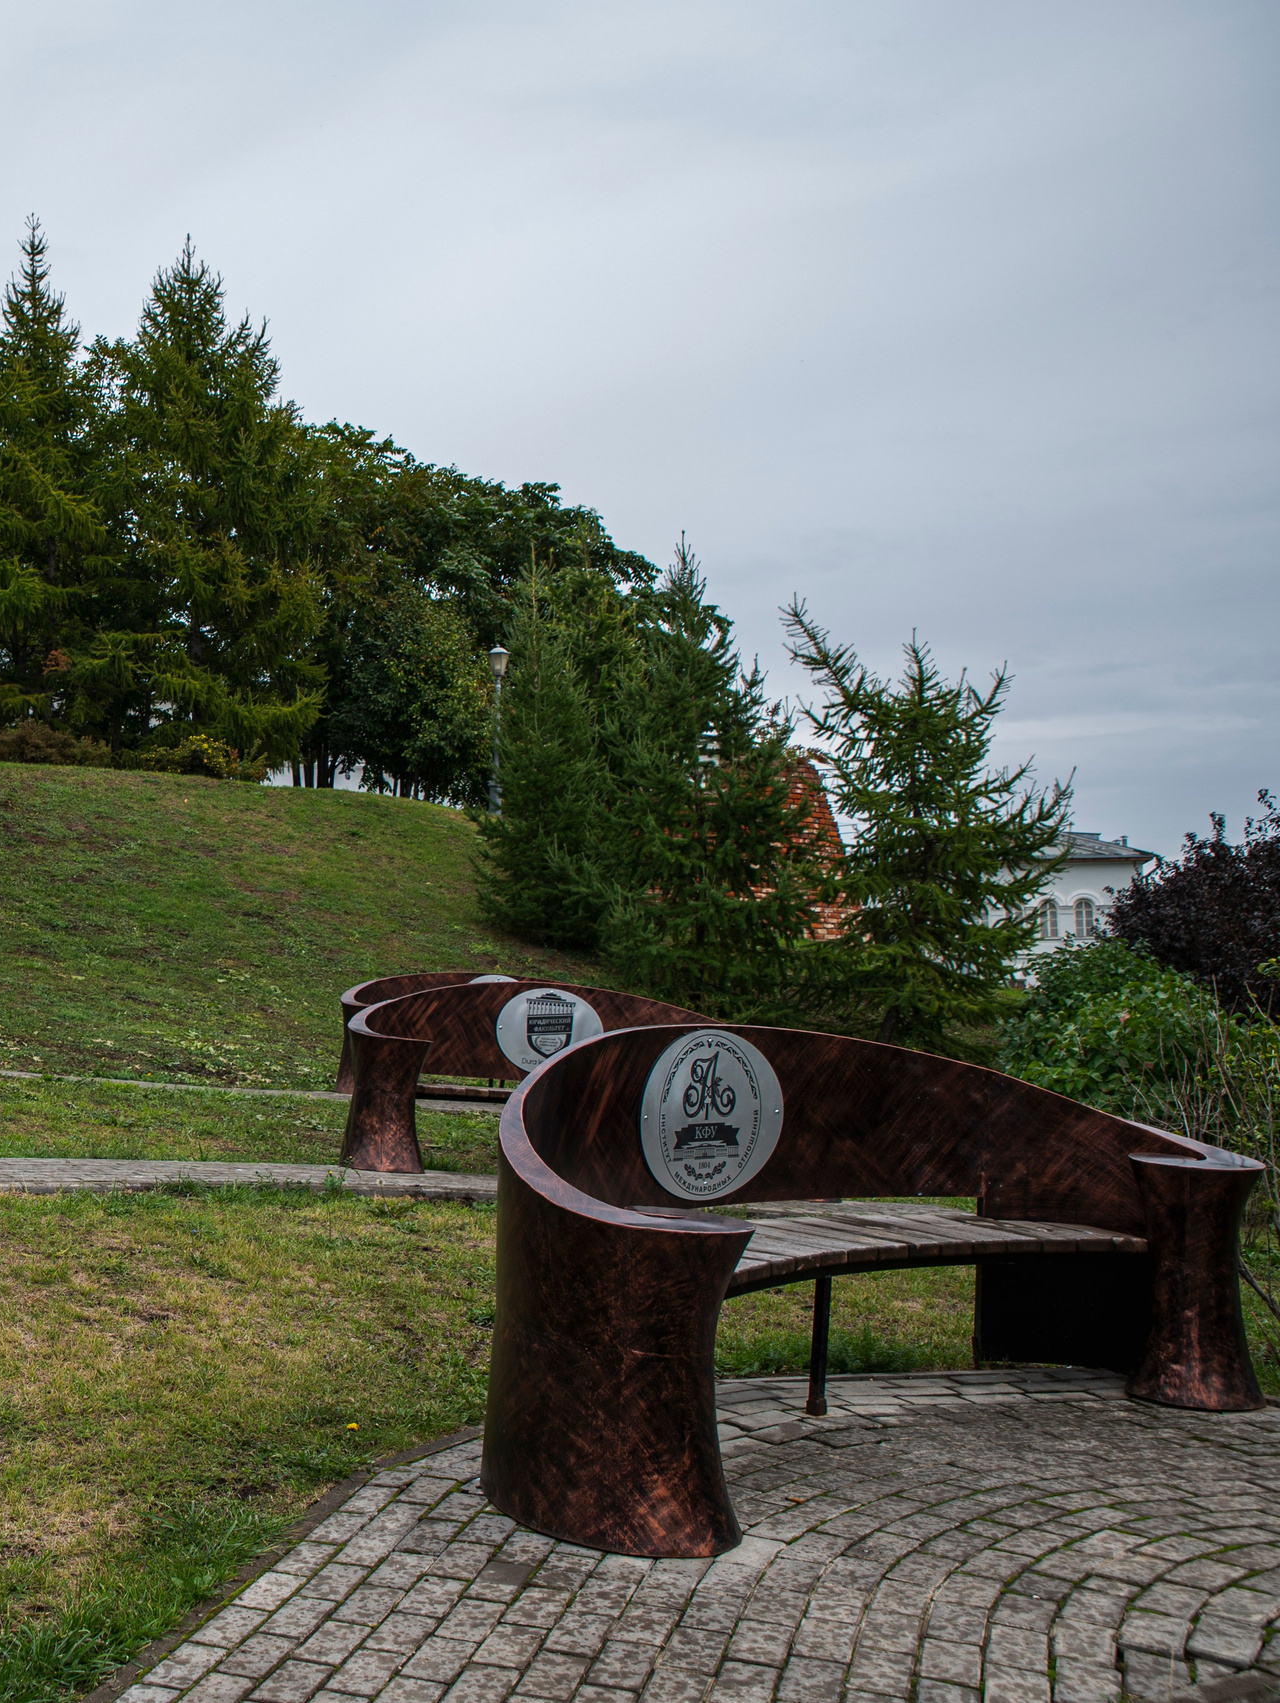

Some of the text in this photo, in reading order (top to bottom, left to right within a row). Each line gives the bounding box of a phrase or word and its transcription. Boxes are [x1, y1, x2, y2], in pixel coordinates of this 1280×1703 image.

[695, 1126, 718, 1139] КФУ
[661, 1109, 759, 1192] ИНСТИТУТ МЕЖДУНАРОДНЫХ ОТНОШЕНИЙ
[698, 1161, 711, 1170] 1804
